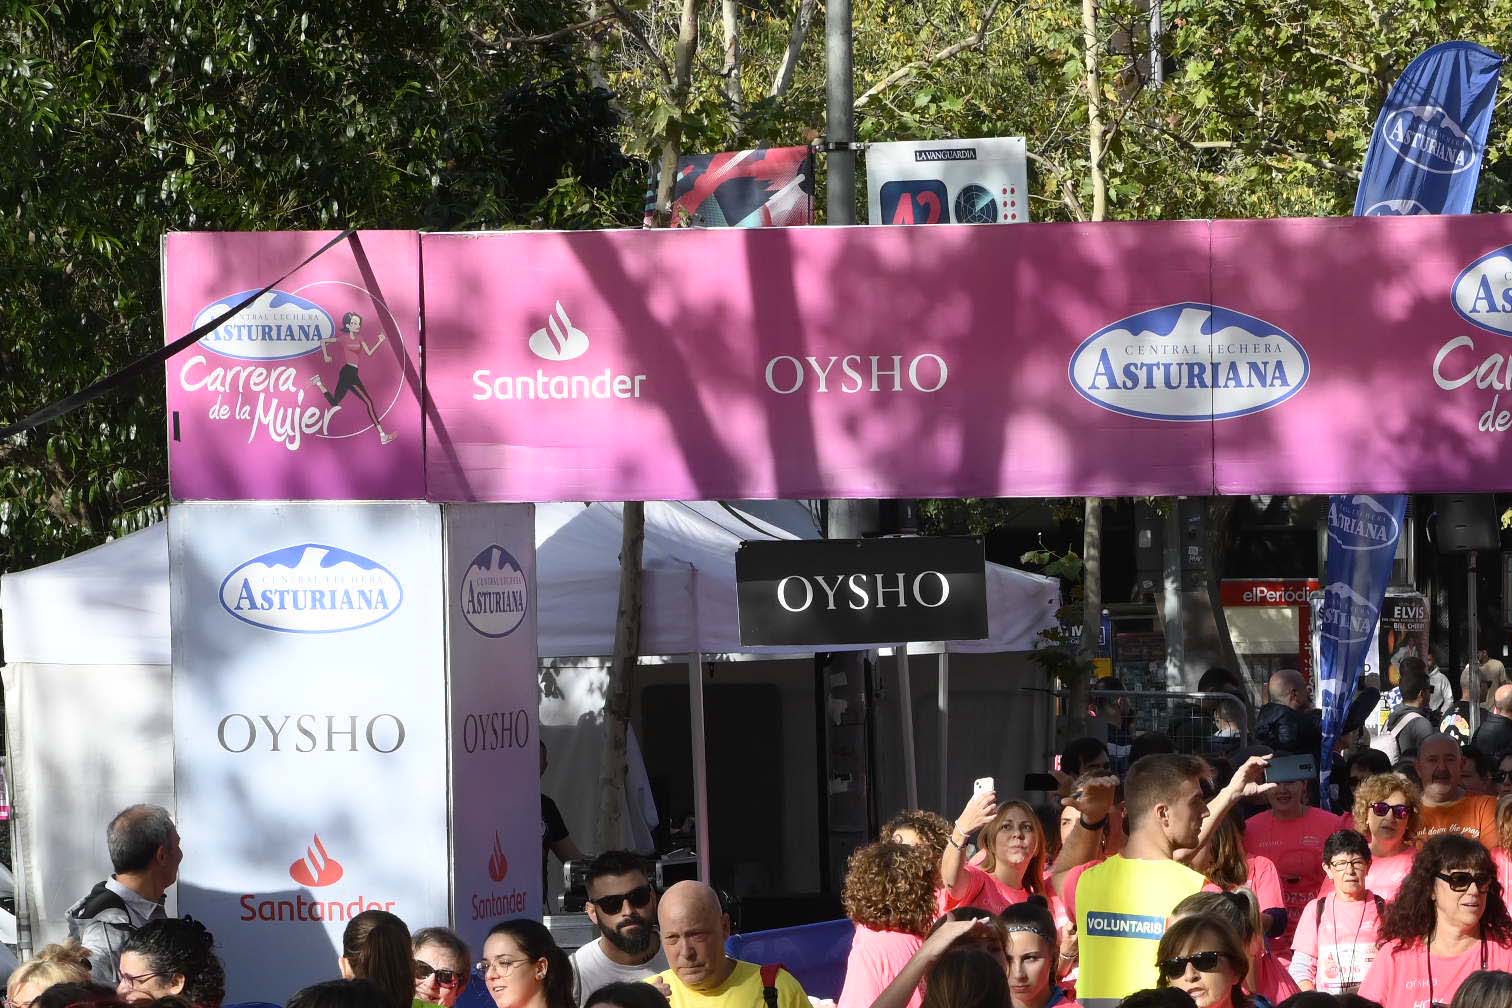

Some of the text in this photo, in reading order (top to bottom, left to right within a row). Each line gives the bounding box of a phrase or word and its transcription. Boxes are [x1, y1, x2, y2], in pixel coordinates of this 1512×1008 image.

[926, 149, 975, 160] VANGUARDIA
[204, 317, 323, 342] ASTURIANA
[1125, 343, 1283, 355] CENTRAL LECHERA
[180, 355, 297, 392] Carrera
[473, 369, 646, 400] Santander
[765, 353, 949, 394] OYSHO
[1088, 348, 1292, 390] ASTURIANA
[209, 389, 342, 451] de la Mujer
[1479, 394, 1511, 433] de
[234, 577, 389, 611] ASTURIANA
[466, 580, 524, 614] ASTURIANA
[777, 571, 950, 613] OYSHO
[1394, 606, 1424, 619] ELVIS
[217, 713, 406, 754] OYSHO
[463, 709, 529, 754] OYSHO
[471, 890, 527, 921] Santander
[1088, 917, 1164, 935] VOLUNTARIS
